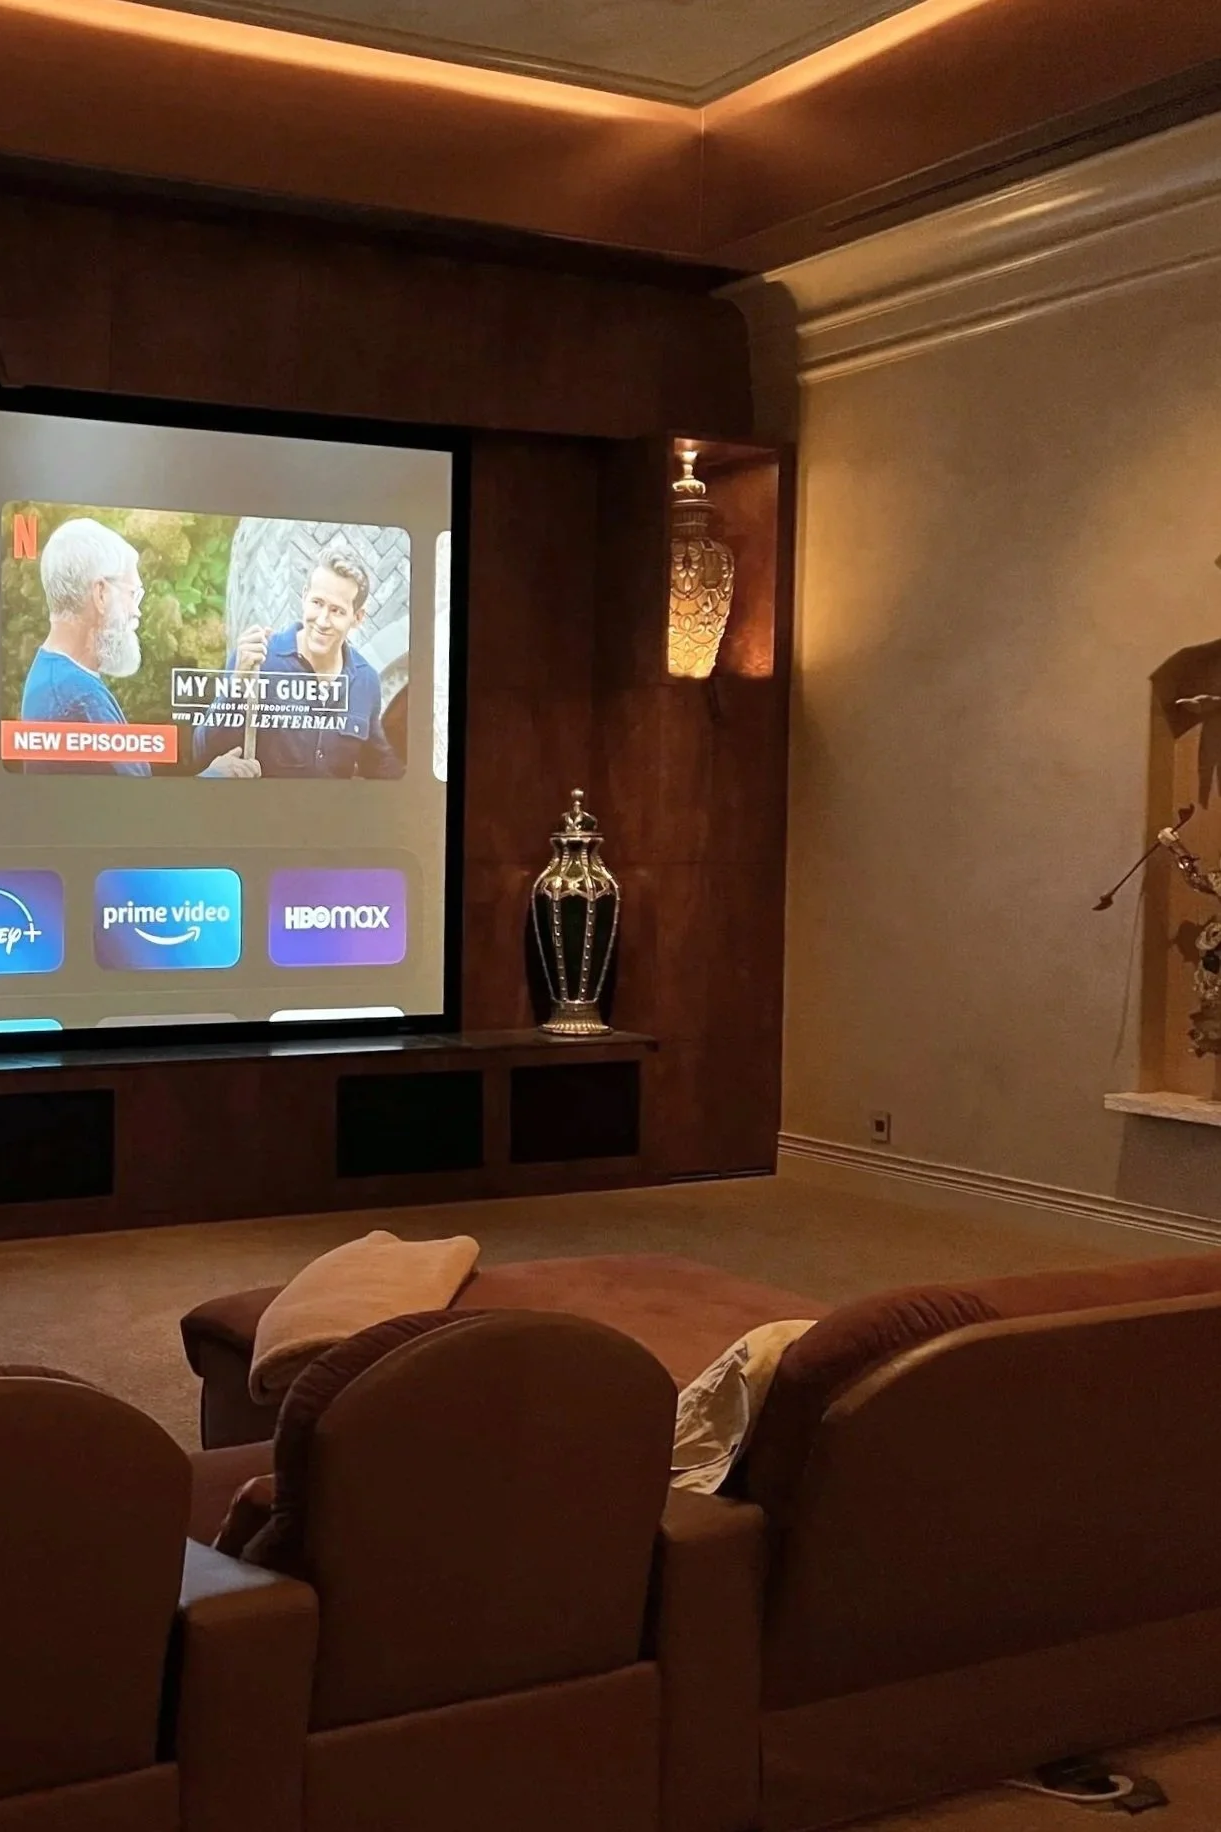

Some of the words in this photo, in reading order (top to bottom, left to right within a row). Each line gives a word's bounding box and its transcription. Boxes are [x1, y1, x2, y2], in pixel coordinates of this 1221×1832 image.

[13, 514, 38, 559] N
[177, 675, 208, 697] MY
[215, 677, 269, 700] NEXT
[276, 680, 342, 702] GUEST
[211, 703, 236, 711] NEEDS
[251, 704, 310, 713] INTRODUCTION
[192, 712, 245, 728] DAVID
[250, 714, 347, 730] LETTERMAN
[14, 732, 62, 751] NEW
[66, 733, 165, 753] EPISODES
[103, 902, 168, 929] prime
[171, 904, 230, 924] video
